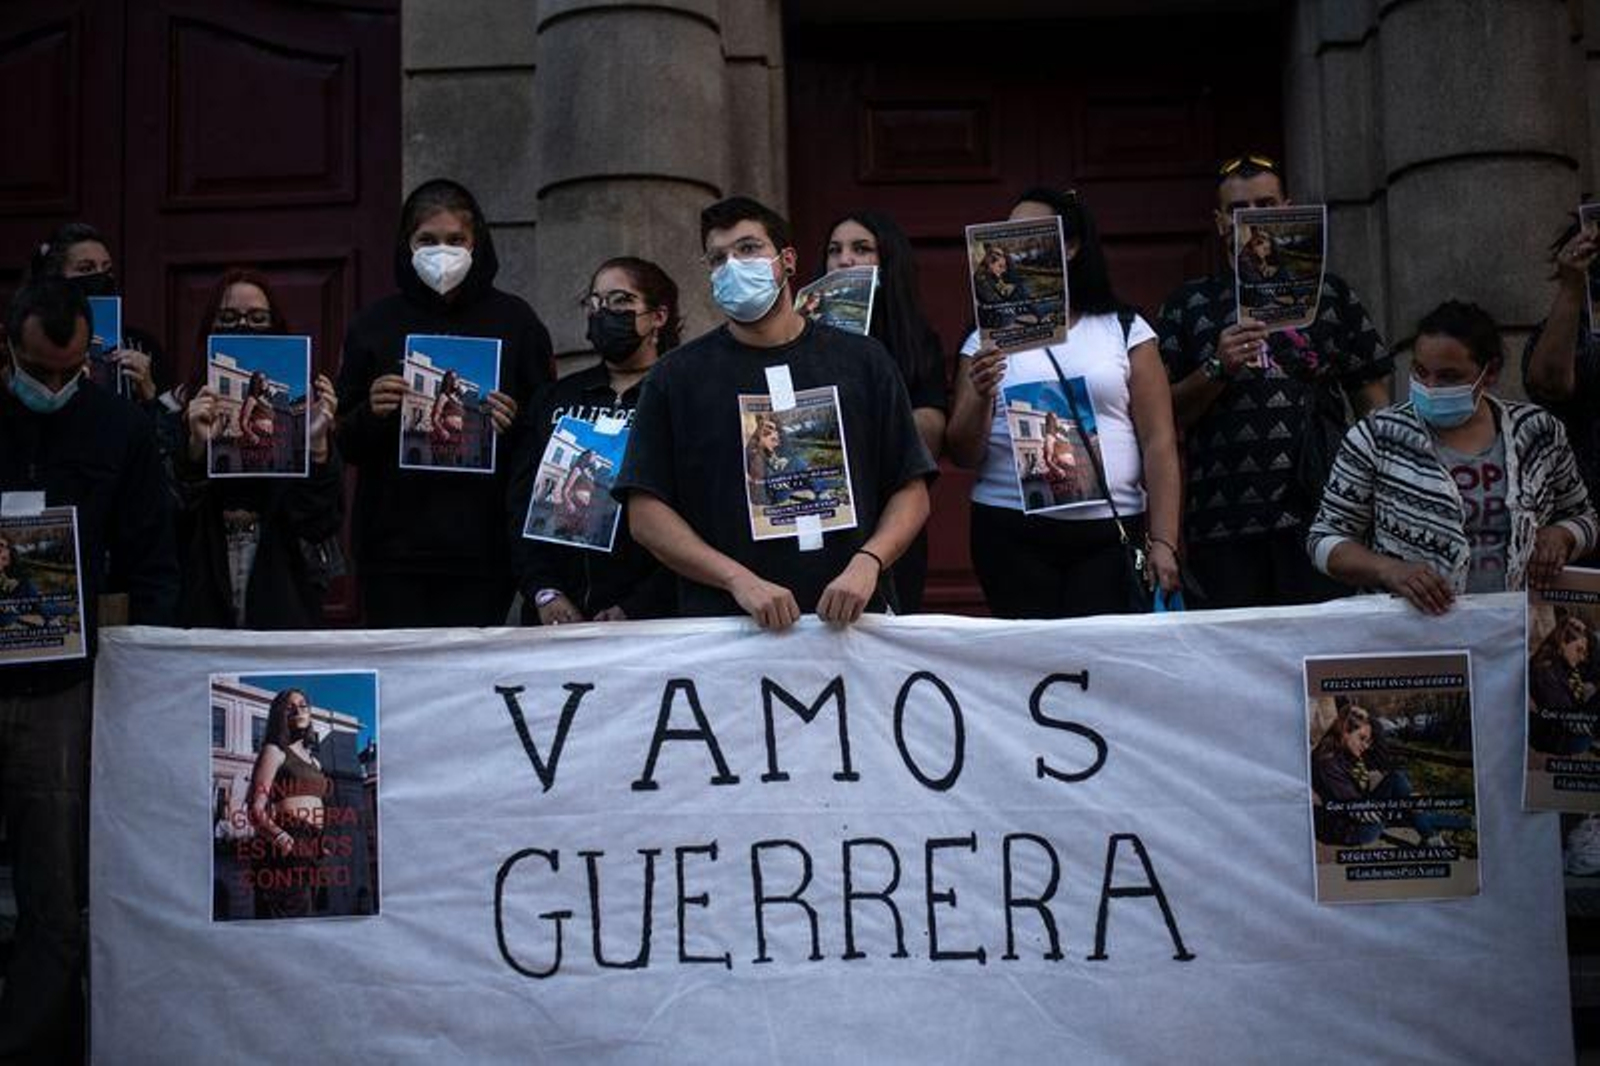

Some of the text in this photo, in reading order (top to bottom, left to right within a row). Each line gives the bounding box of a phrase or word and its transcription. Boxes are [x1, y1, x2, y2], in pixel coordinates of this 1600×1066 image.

[494, 669, 1108, 793] VAMOS
[231, 805, 357, 829] GUERRERA
[237, 835, 352, 861] ESTAMOS
[240, 865, 351, 891] CONTIGO
[494, 831, 1196, 979] GUERRERA
